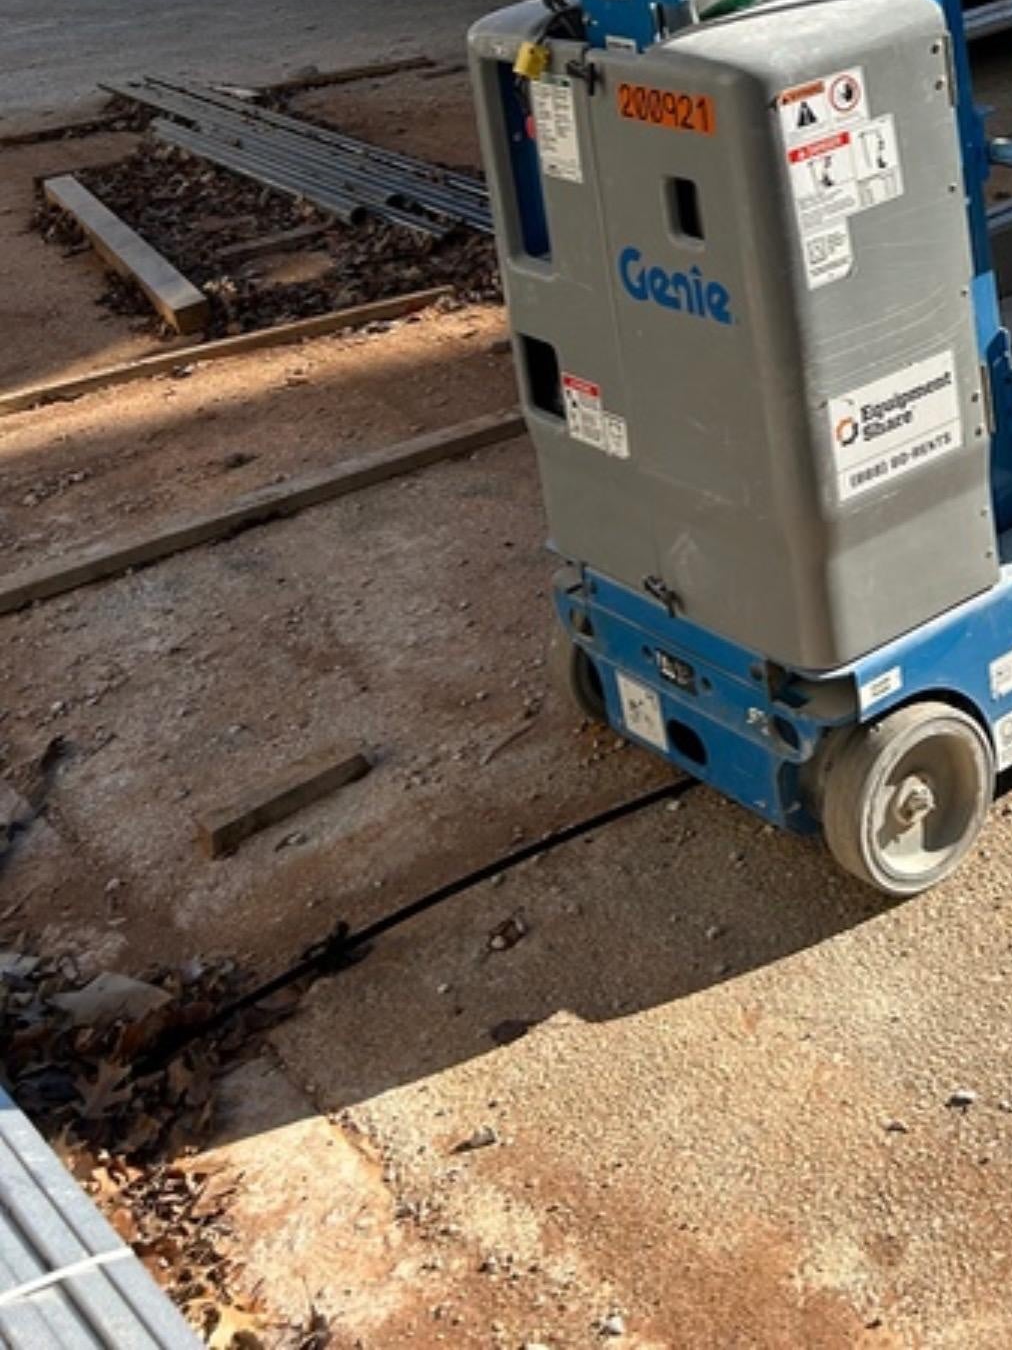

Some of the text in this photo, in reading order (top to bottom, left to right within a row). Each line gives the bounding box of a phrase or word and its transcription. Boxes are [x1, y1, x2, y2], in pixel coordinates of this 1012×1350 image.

[618, 83, 709, 133] 200921
[619, 246, 733, 325] Genie
[861, 371, 952, 422] Equipment
[863, 410, 913, 441] Share
